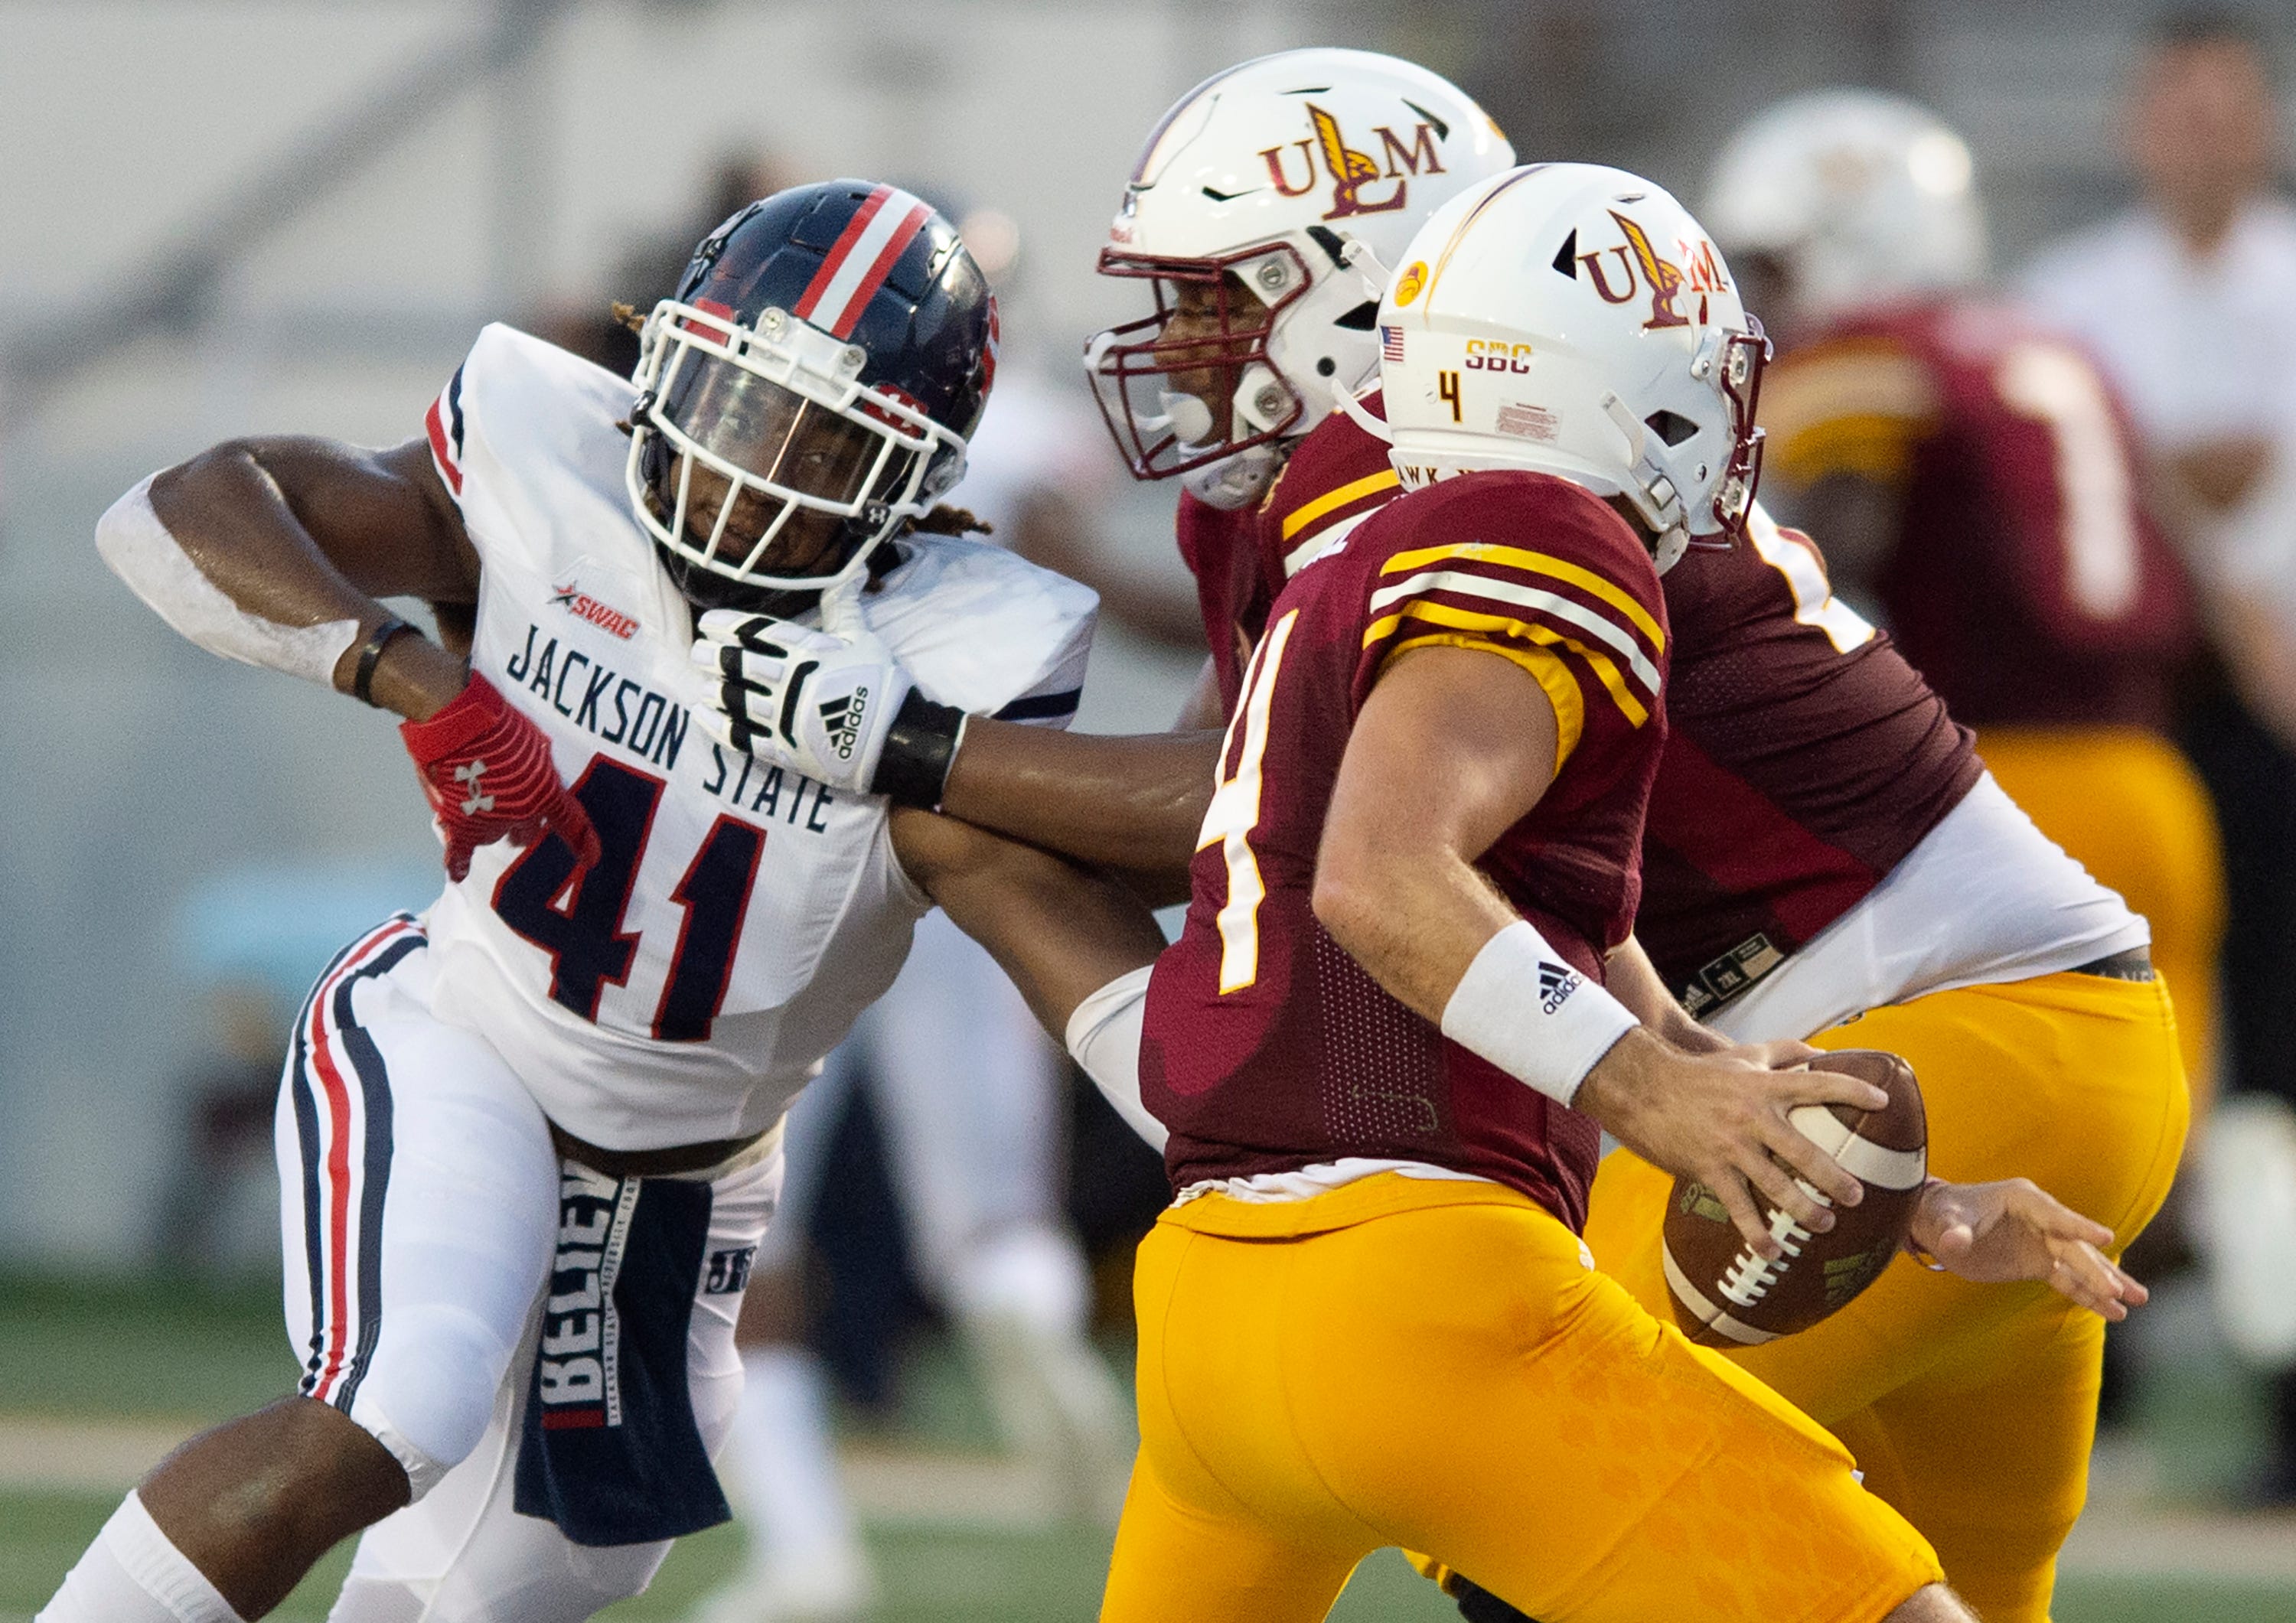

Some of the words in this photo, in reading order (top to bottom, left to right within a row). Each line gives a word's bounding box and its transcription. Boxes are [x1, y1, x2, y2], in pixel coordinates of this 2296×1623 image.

[1257, 101, 1448, 221] ULM
[1465, 339, 1532, 374] SBC
[1438, 370, 1463, 425] 4
[571, 594, 639, 640] SWAC
[506, 624, 690, 771] JACKSON
[838, 686, 869, 759] adidas
[491, 751, 768, 1043] 41
[1543, 973, 1583, 1015] adida
